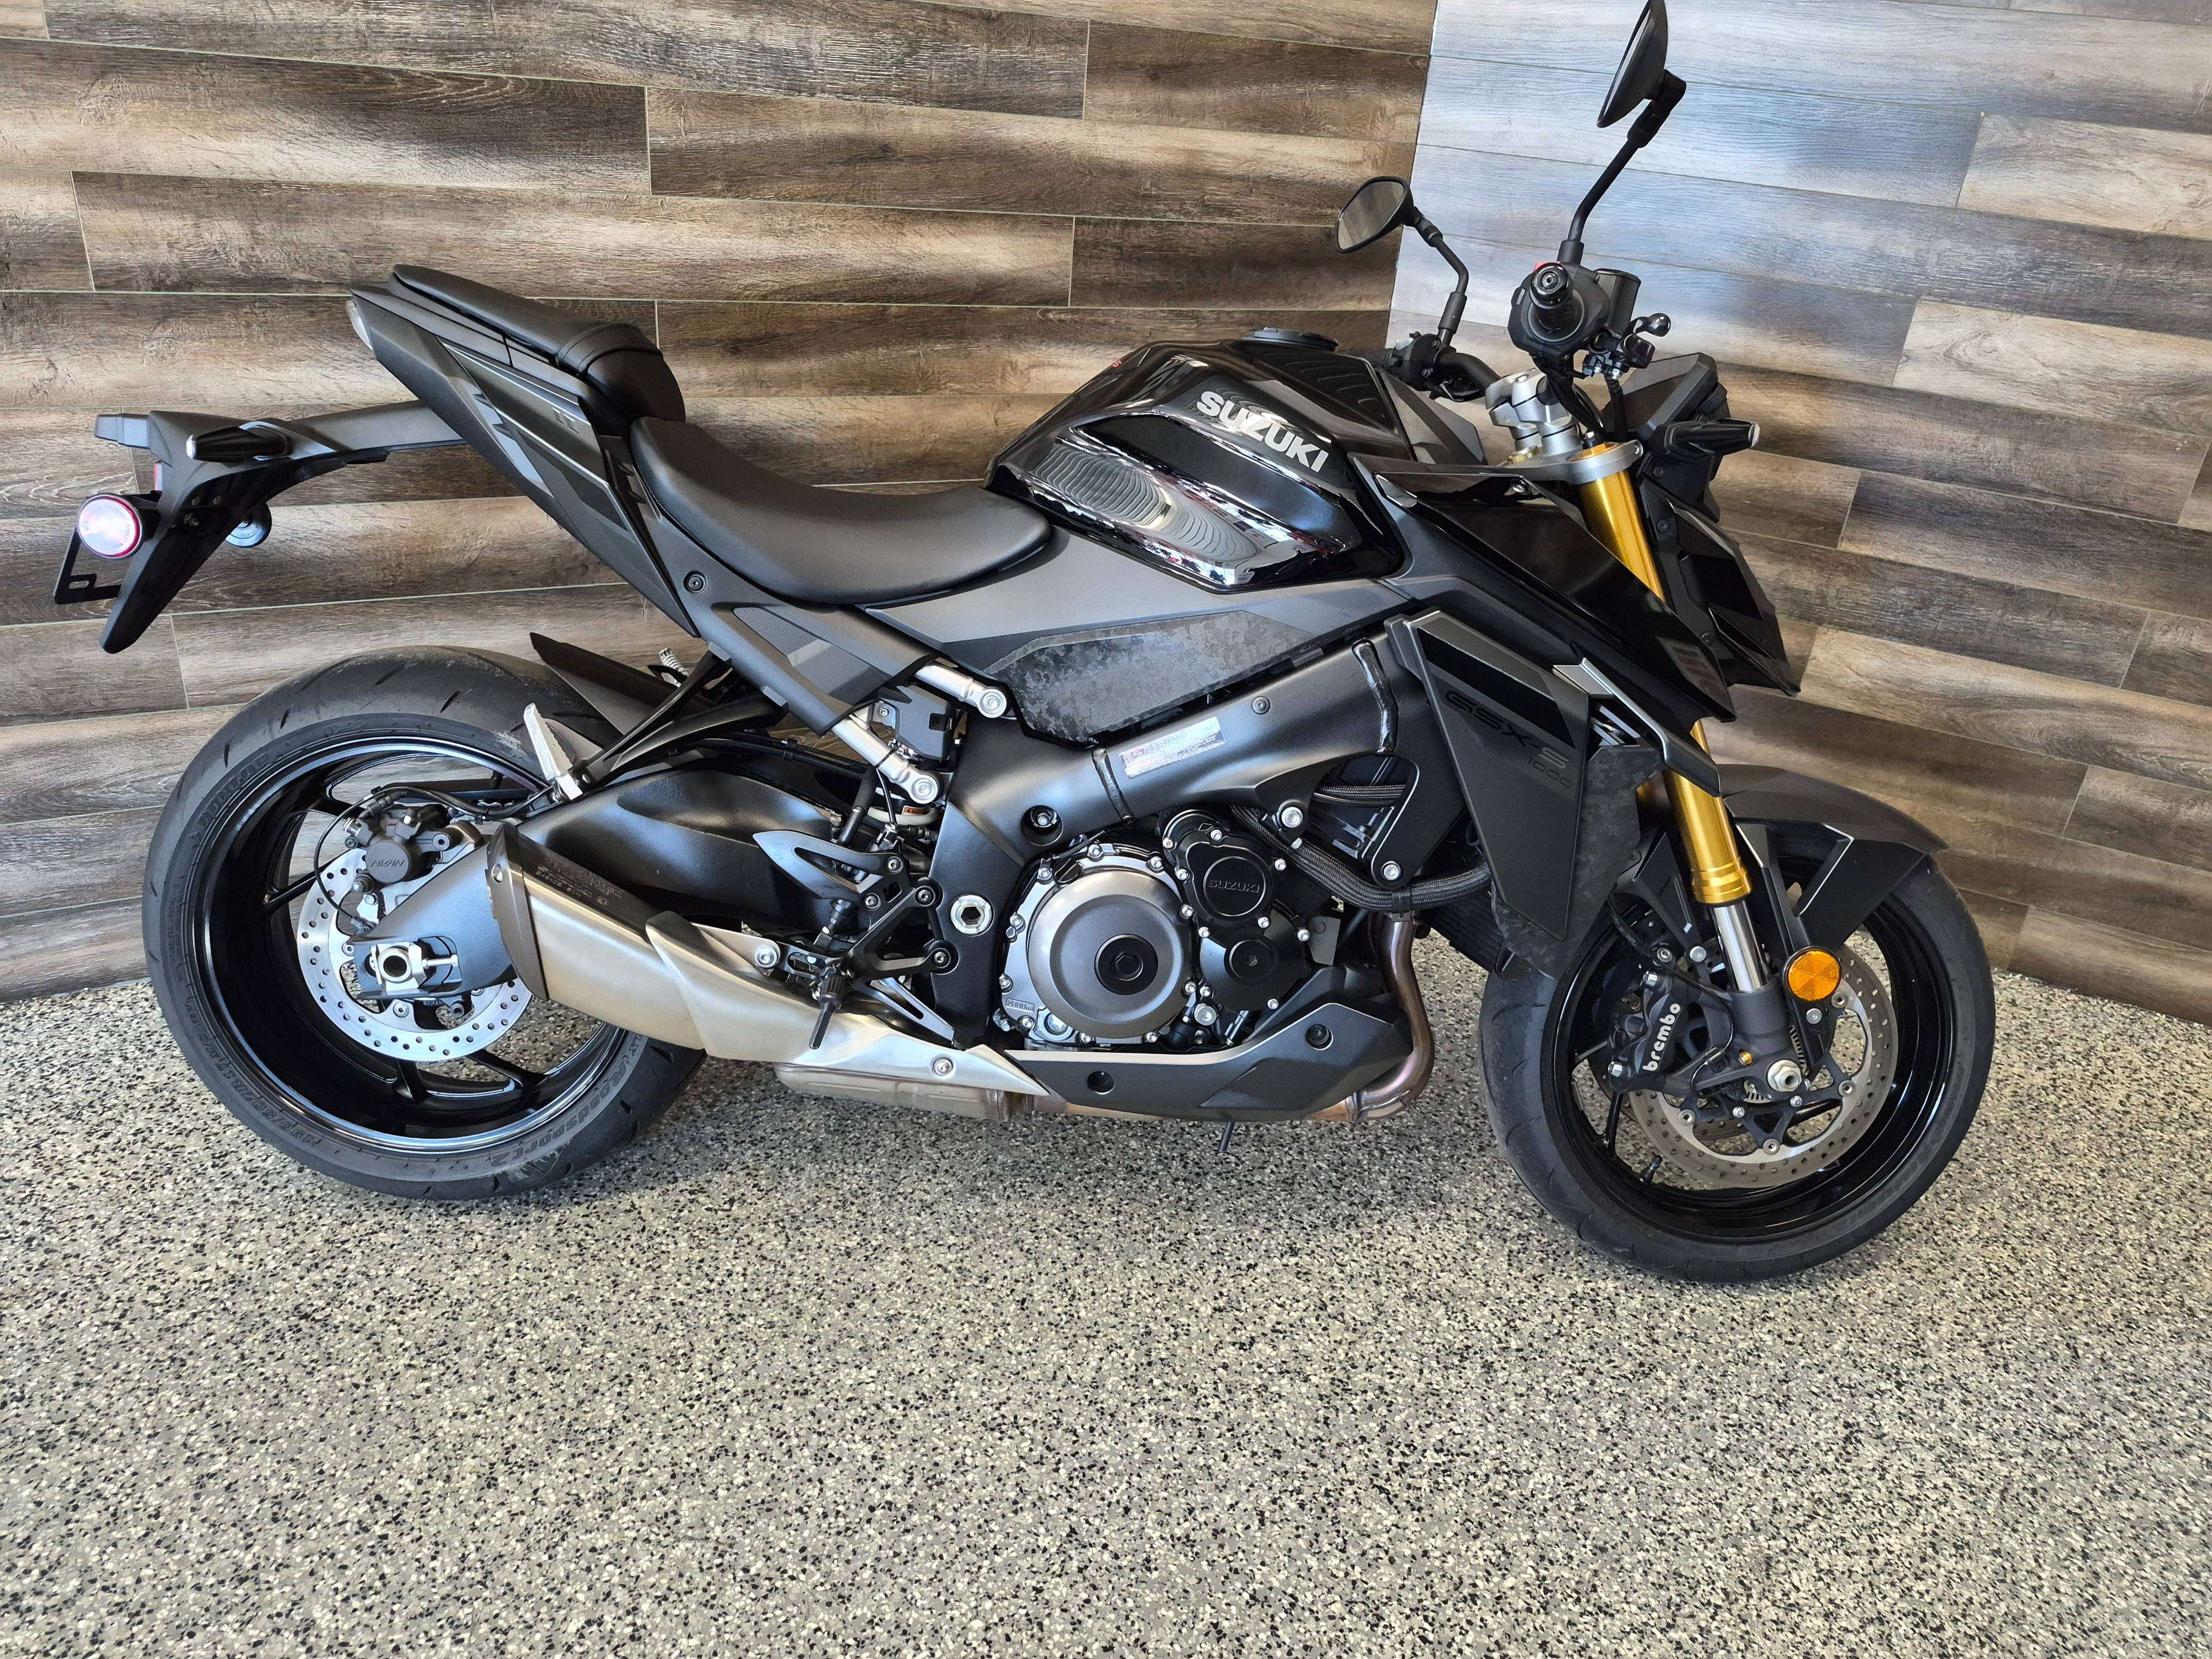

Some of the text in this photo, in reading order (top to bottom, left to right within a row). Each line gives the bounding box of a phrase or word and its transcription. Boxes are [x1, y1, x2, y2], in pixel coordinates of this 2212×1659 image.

[1197, 390, 1329, 473] SUZUKI
[198, 754, 269, 828] DUNLOP
[1527, 756, 1573, 788] 1000
[1208, 880, 1260, 893] SUZUKI
[1642, 1003, 1681, 1071] brembo
